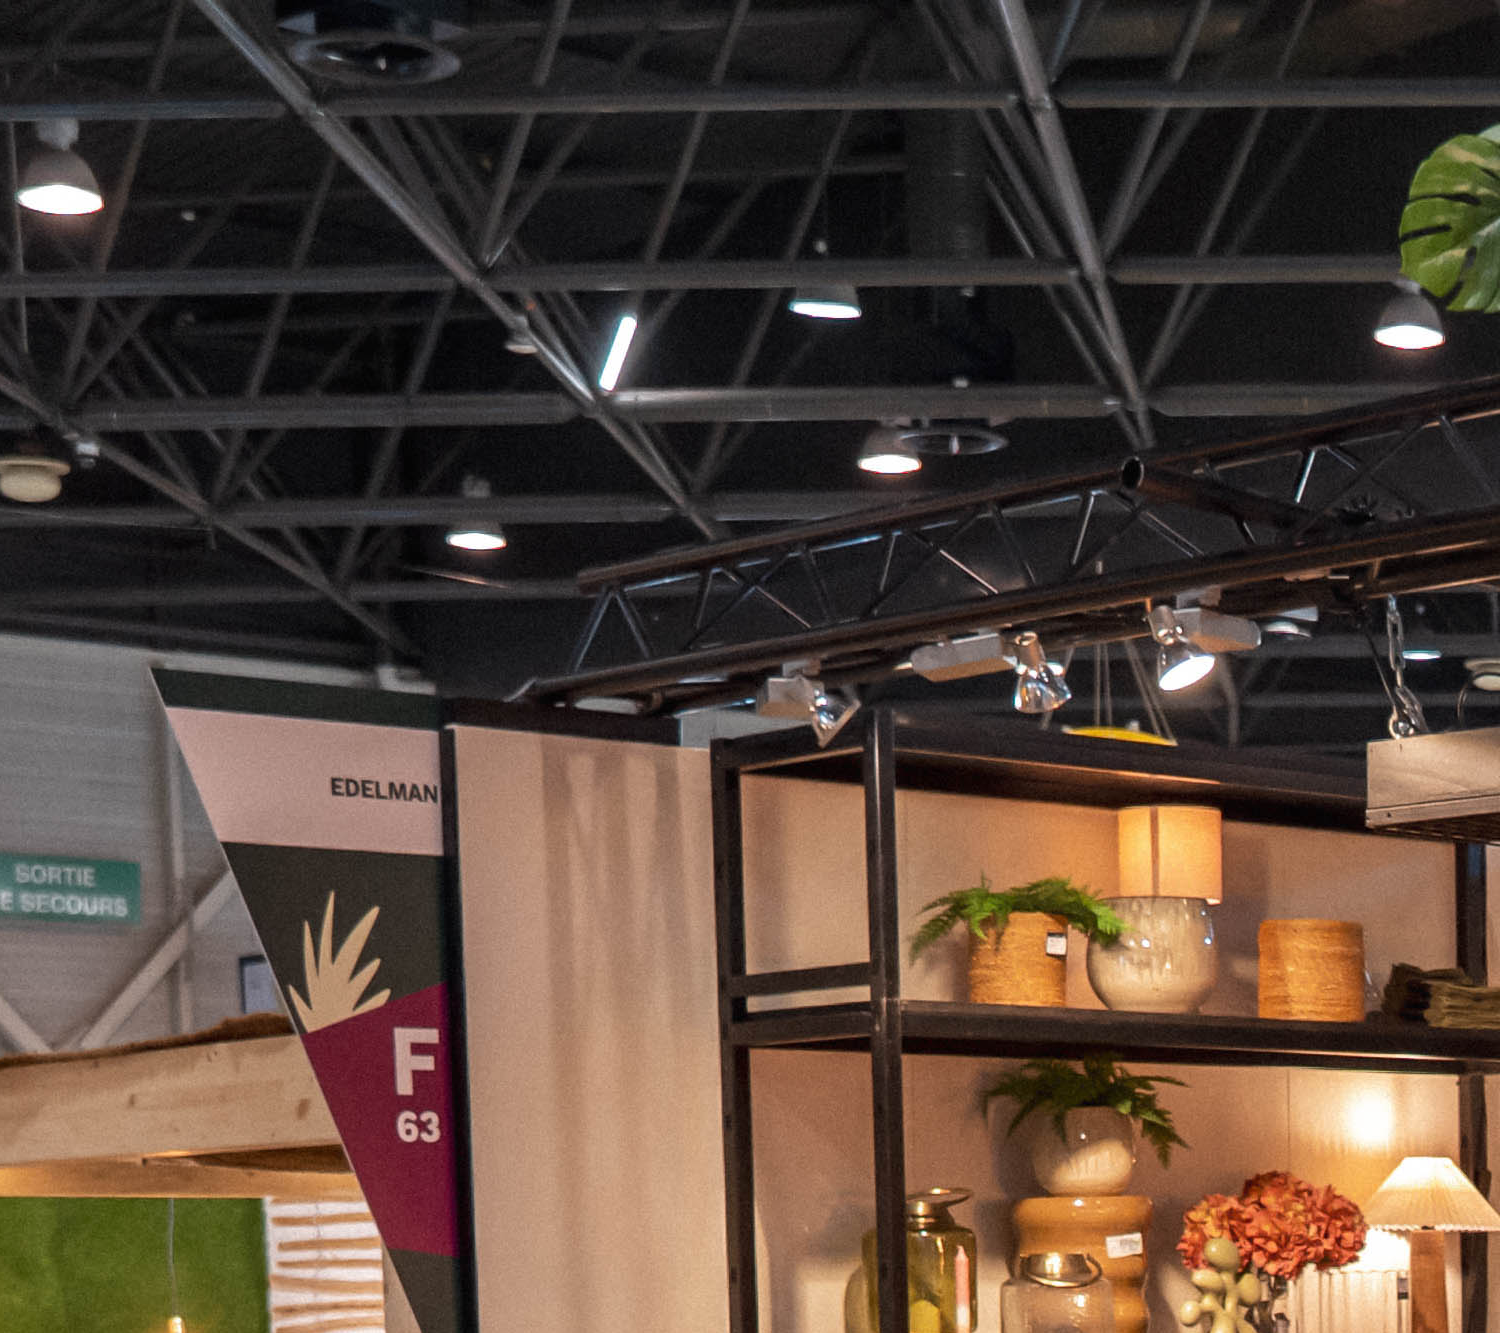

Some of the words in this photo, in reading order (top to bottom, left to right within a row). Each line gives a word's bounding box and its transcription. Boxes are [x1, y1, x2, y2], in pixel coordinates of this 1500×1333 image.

[330, 776, 439, 804] EDELMAN
[14, 863, 97, 888] SORTIE
[18, 891, 129, 918] SECOURS
[392, 1027, 440, 1096] F
[396, 1111, 442, 1144] 63
